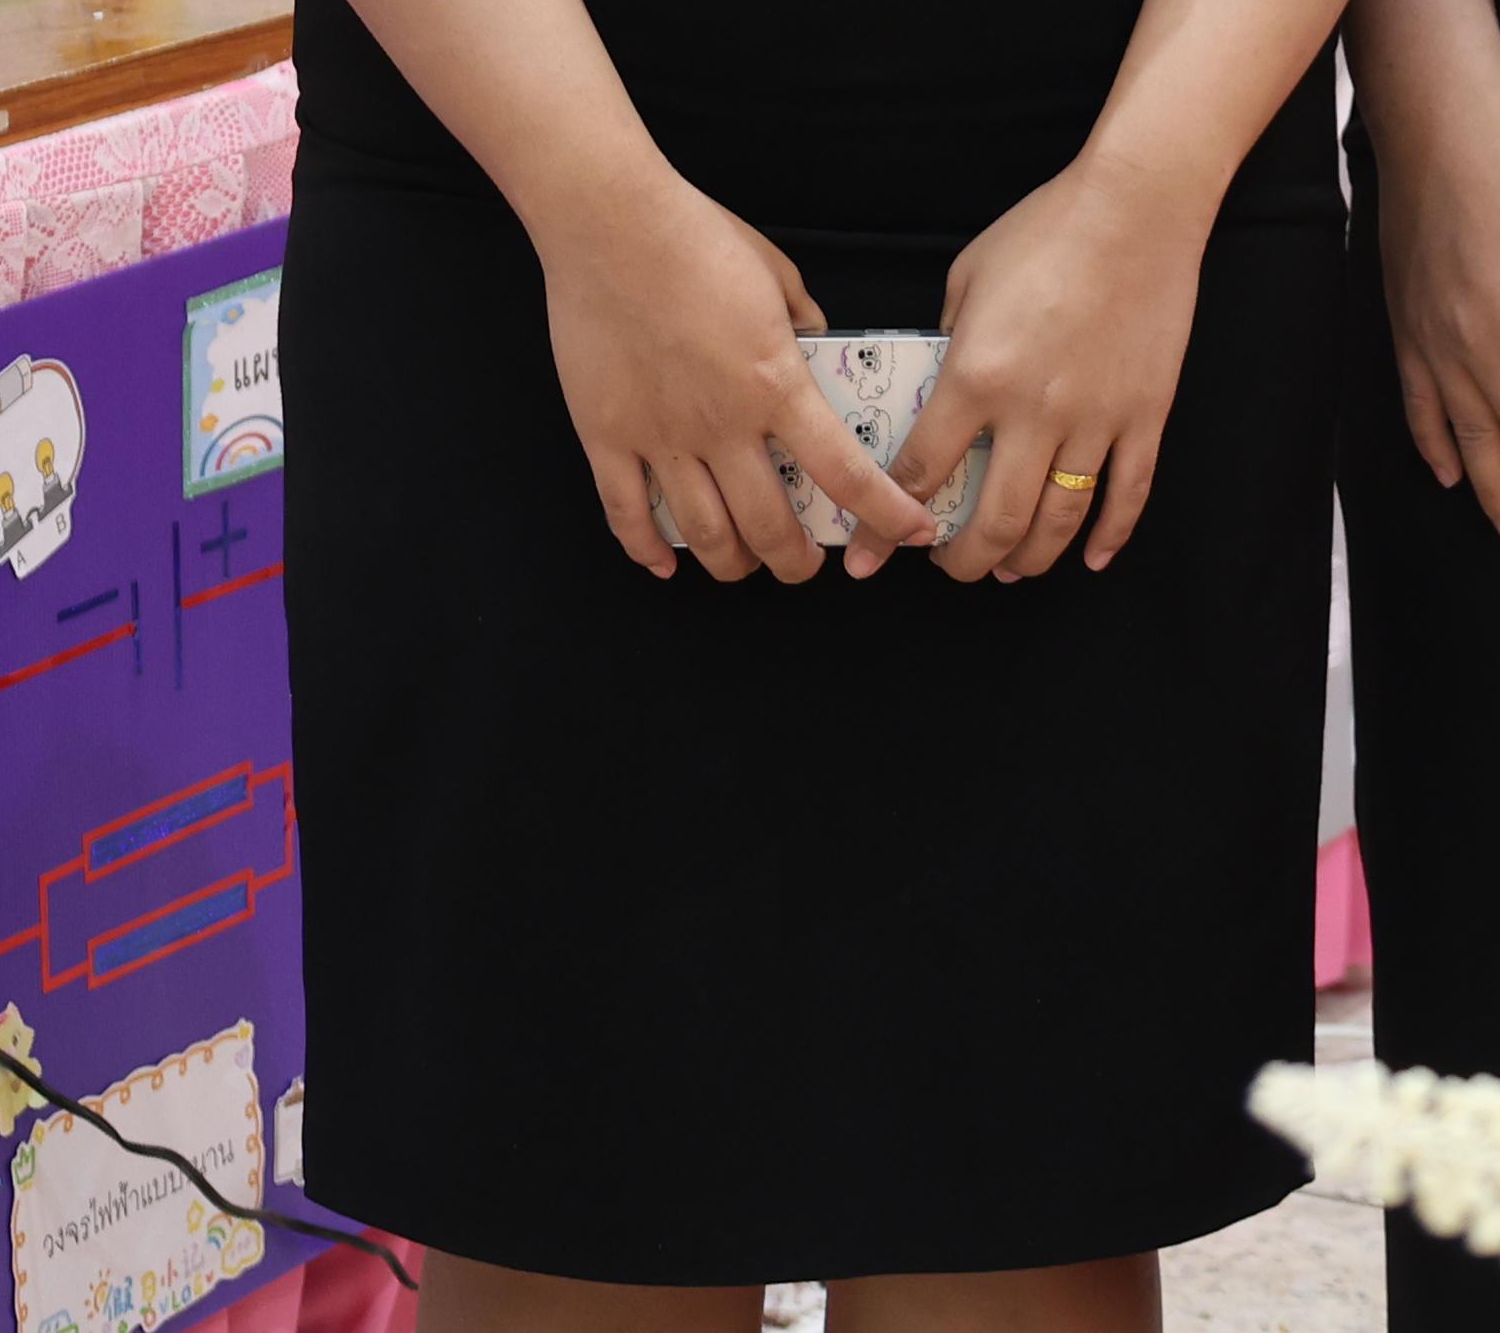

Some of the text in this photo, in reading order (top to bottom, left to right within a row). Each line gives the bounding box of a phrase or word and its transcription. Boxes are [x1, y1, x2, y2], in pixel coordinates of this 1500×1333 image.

[55, 513, 67, 531] B
[15, 550, 26, 570] A
[43, 1139, 235, 1259] วงจรไฟฟ้าแบบนาน
